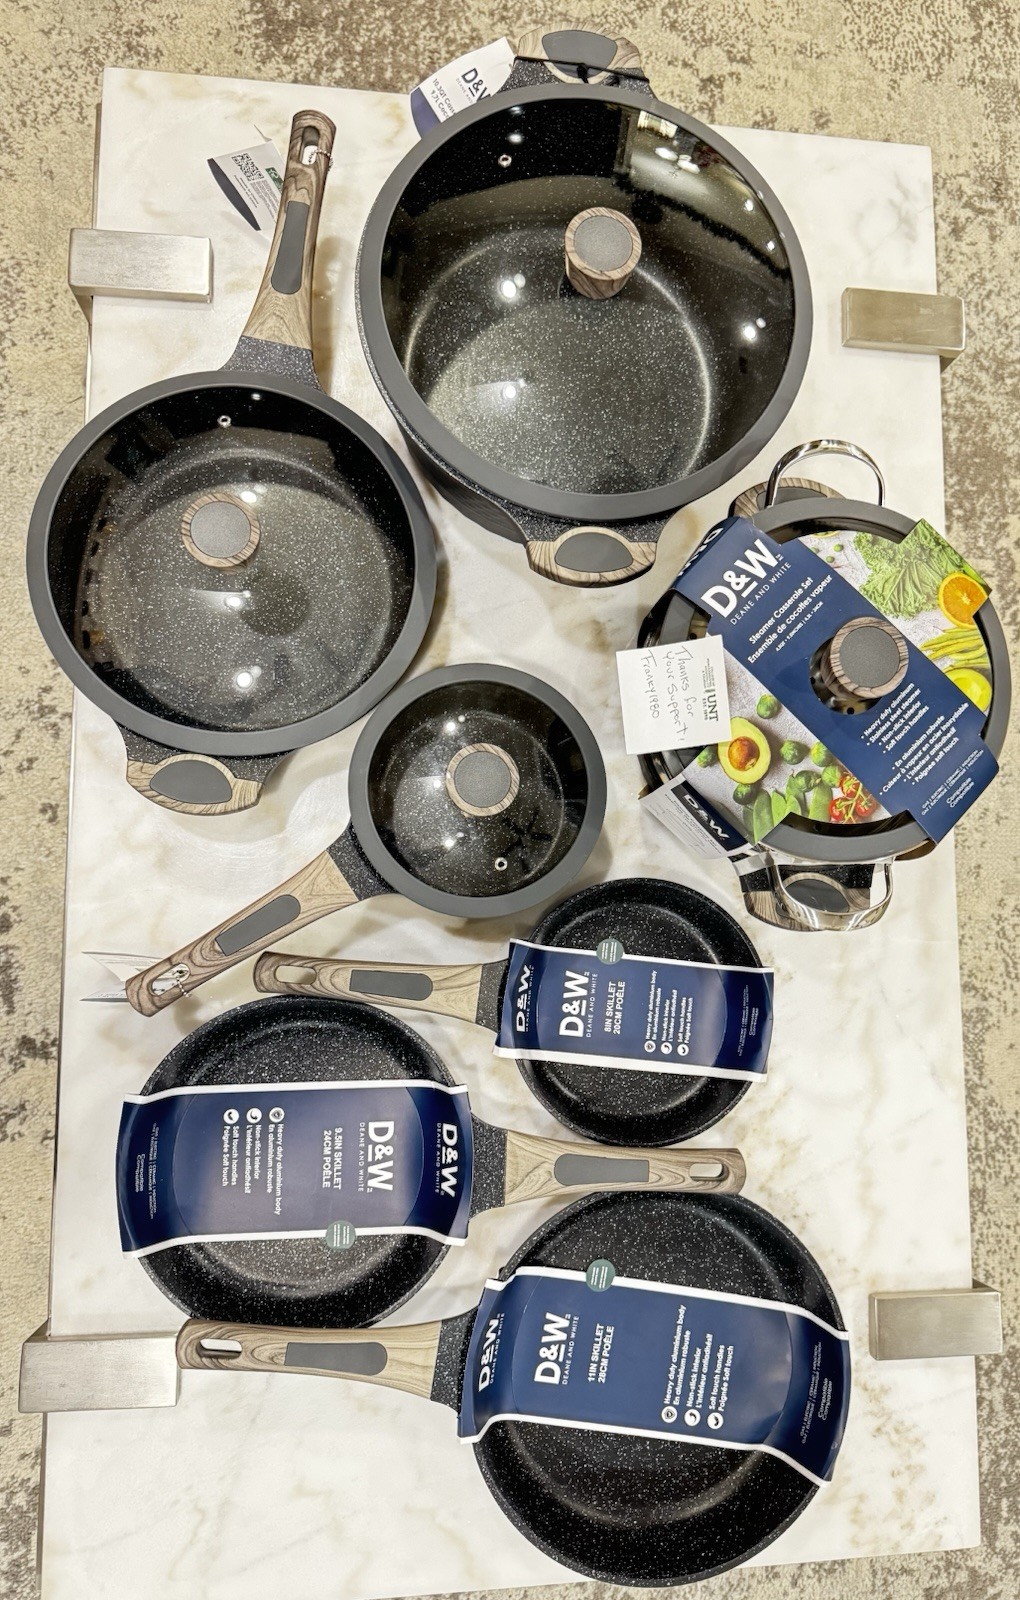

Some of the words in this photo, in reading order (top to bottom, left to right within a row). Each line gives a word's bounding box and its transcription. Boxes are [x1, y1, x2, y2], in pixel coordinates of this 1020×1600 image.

[700, 538, 781, 618] D&W
[729, 599, 754, 624] DEANE
[753, 583, 770, 600] AND
[769, 561, 791, 583] WHITE
[746, 631, 778, 663] Ensemble
[774, 621, 787, 634] de
[783, 595, 812, 624] cocottes
[808, 573, 834, 599] vapeur
[748, 615, 776, 644] Steamer
[772, 586, 804, 619] Casserole
[799, 575, 813, 589] Set
[675, 645, 694, 691] Thanks
[706, 693, 718, 722] UNT
[863, 718, 881, 736] Heavy
[878, 706, 893, 720] duty
[889, 682, 915, 708] aluminum
[868, 719, 891, 742] Stainless
[888, 707, 902, 721] steel
[899, 687, 921, 710] steamer
[880, 716, 905, 742] Non-stick
[902, 699, 921, 719] interior
[884, 738, 897, 750] Soft
[893, 724, 910, 741] touch
[907, 704, 929, 726] handles
[893, 758, 903, 767] En
[900, 732, 927, 760] aluminium
[924, 713, 945, 735] robuste
[881, 771, 902, 793] Cuiseur
[904, 749, 924, 770] vapeur
[921, 743, 930, 751] en
[927, 728, 943, 744] acier
[939, 701, 969, 731] inoxydable
[942, 735, 959, 753] touch
[513, 964, 533, 1032] D&W
[558, 970, 590, 1038] D&W
[605, 980, 616, 1016] SKILLET
[614, 980, 625, 1009] POÊLE
[585, 1014, 593, 1037] DEANE
[603, 1018, 612, 1032] 8IN
[613, 1011, 622, 1034] 20CM
[268, 1123, 274, 1132] En
[275, 1145, 283, 1161] duty
[367, 1119, 393, 1192] D&W
[441, 1121, 456, 1198] D&W
[322, 1156, 331, 1188] POÊLE
[333, 1151, 341, 1190] SKILLET
[569, 1315, 579, 1338] WHITE
[677, 1304, 686, 1324] body
[477, 1317, 499, 1392] D&W
[533, 1311, 571, 1384] D&W
[566, 1340, 574, 1357] AND
[590, 1323, 604, 1361] SKILLET
[600, 1325, 614, 1356] POÊLE
[670, 1324, 682, 1362] aluminium
[681, 1329, 691, 1357] robuste
[724, 1345, 734, 1366] touch
[489, 1357, 497, 1383] DEANE
[562, 1359, 571, 1384] DEANE
[587, 1362, 597, 1382] 11IN
[598, 1357, 609, 1383] 28CM
[667, 1363, 677, 1380] duty
[714, 1344, 725, 1373] handles
[674, 1358, 686, 1395] aluminium
[686, 1372, 697, 1407] Non-stick
[692, 1346, 701, 1372] interior
[711, 1374, 720, 1395] touch
[722, 1367, 730, 1381] Soft
[663, 1380, 674, 1403] Heavy
[673, 1395, 680, 1405] En
[708, 1395, 717, 1410] Soft
[718, 1381, 729, 1411] Poignée
